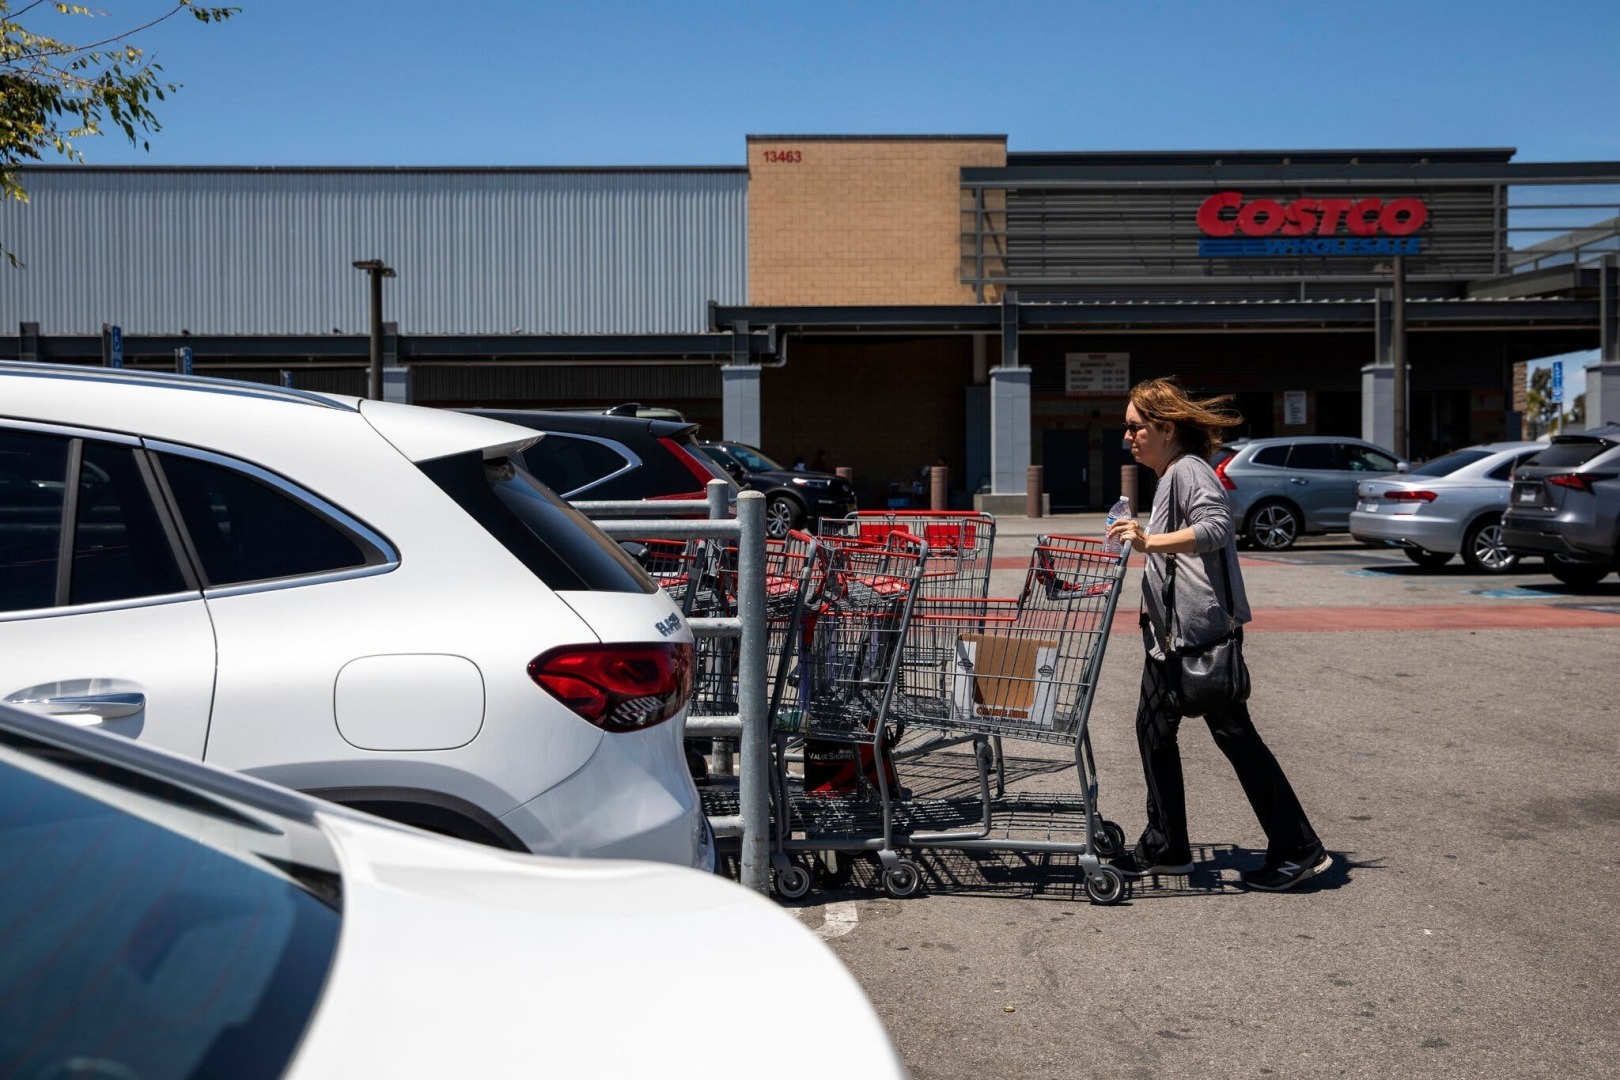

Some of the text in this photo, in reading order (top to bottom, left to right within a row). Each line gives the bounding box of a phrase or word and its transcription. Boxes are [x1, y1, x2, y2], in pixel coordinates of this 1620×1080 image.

[763, 150, 802, 163] 13463
[1196, 191, 1428, 237] COSTCO
[1265, 238, 1422, 255] WHOLESALE
